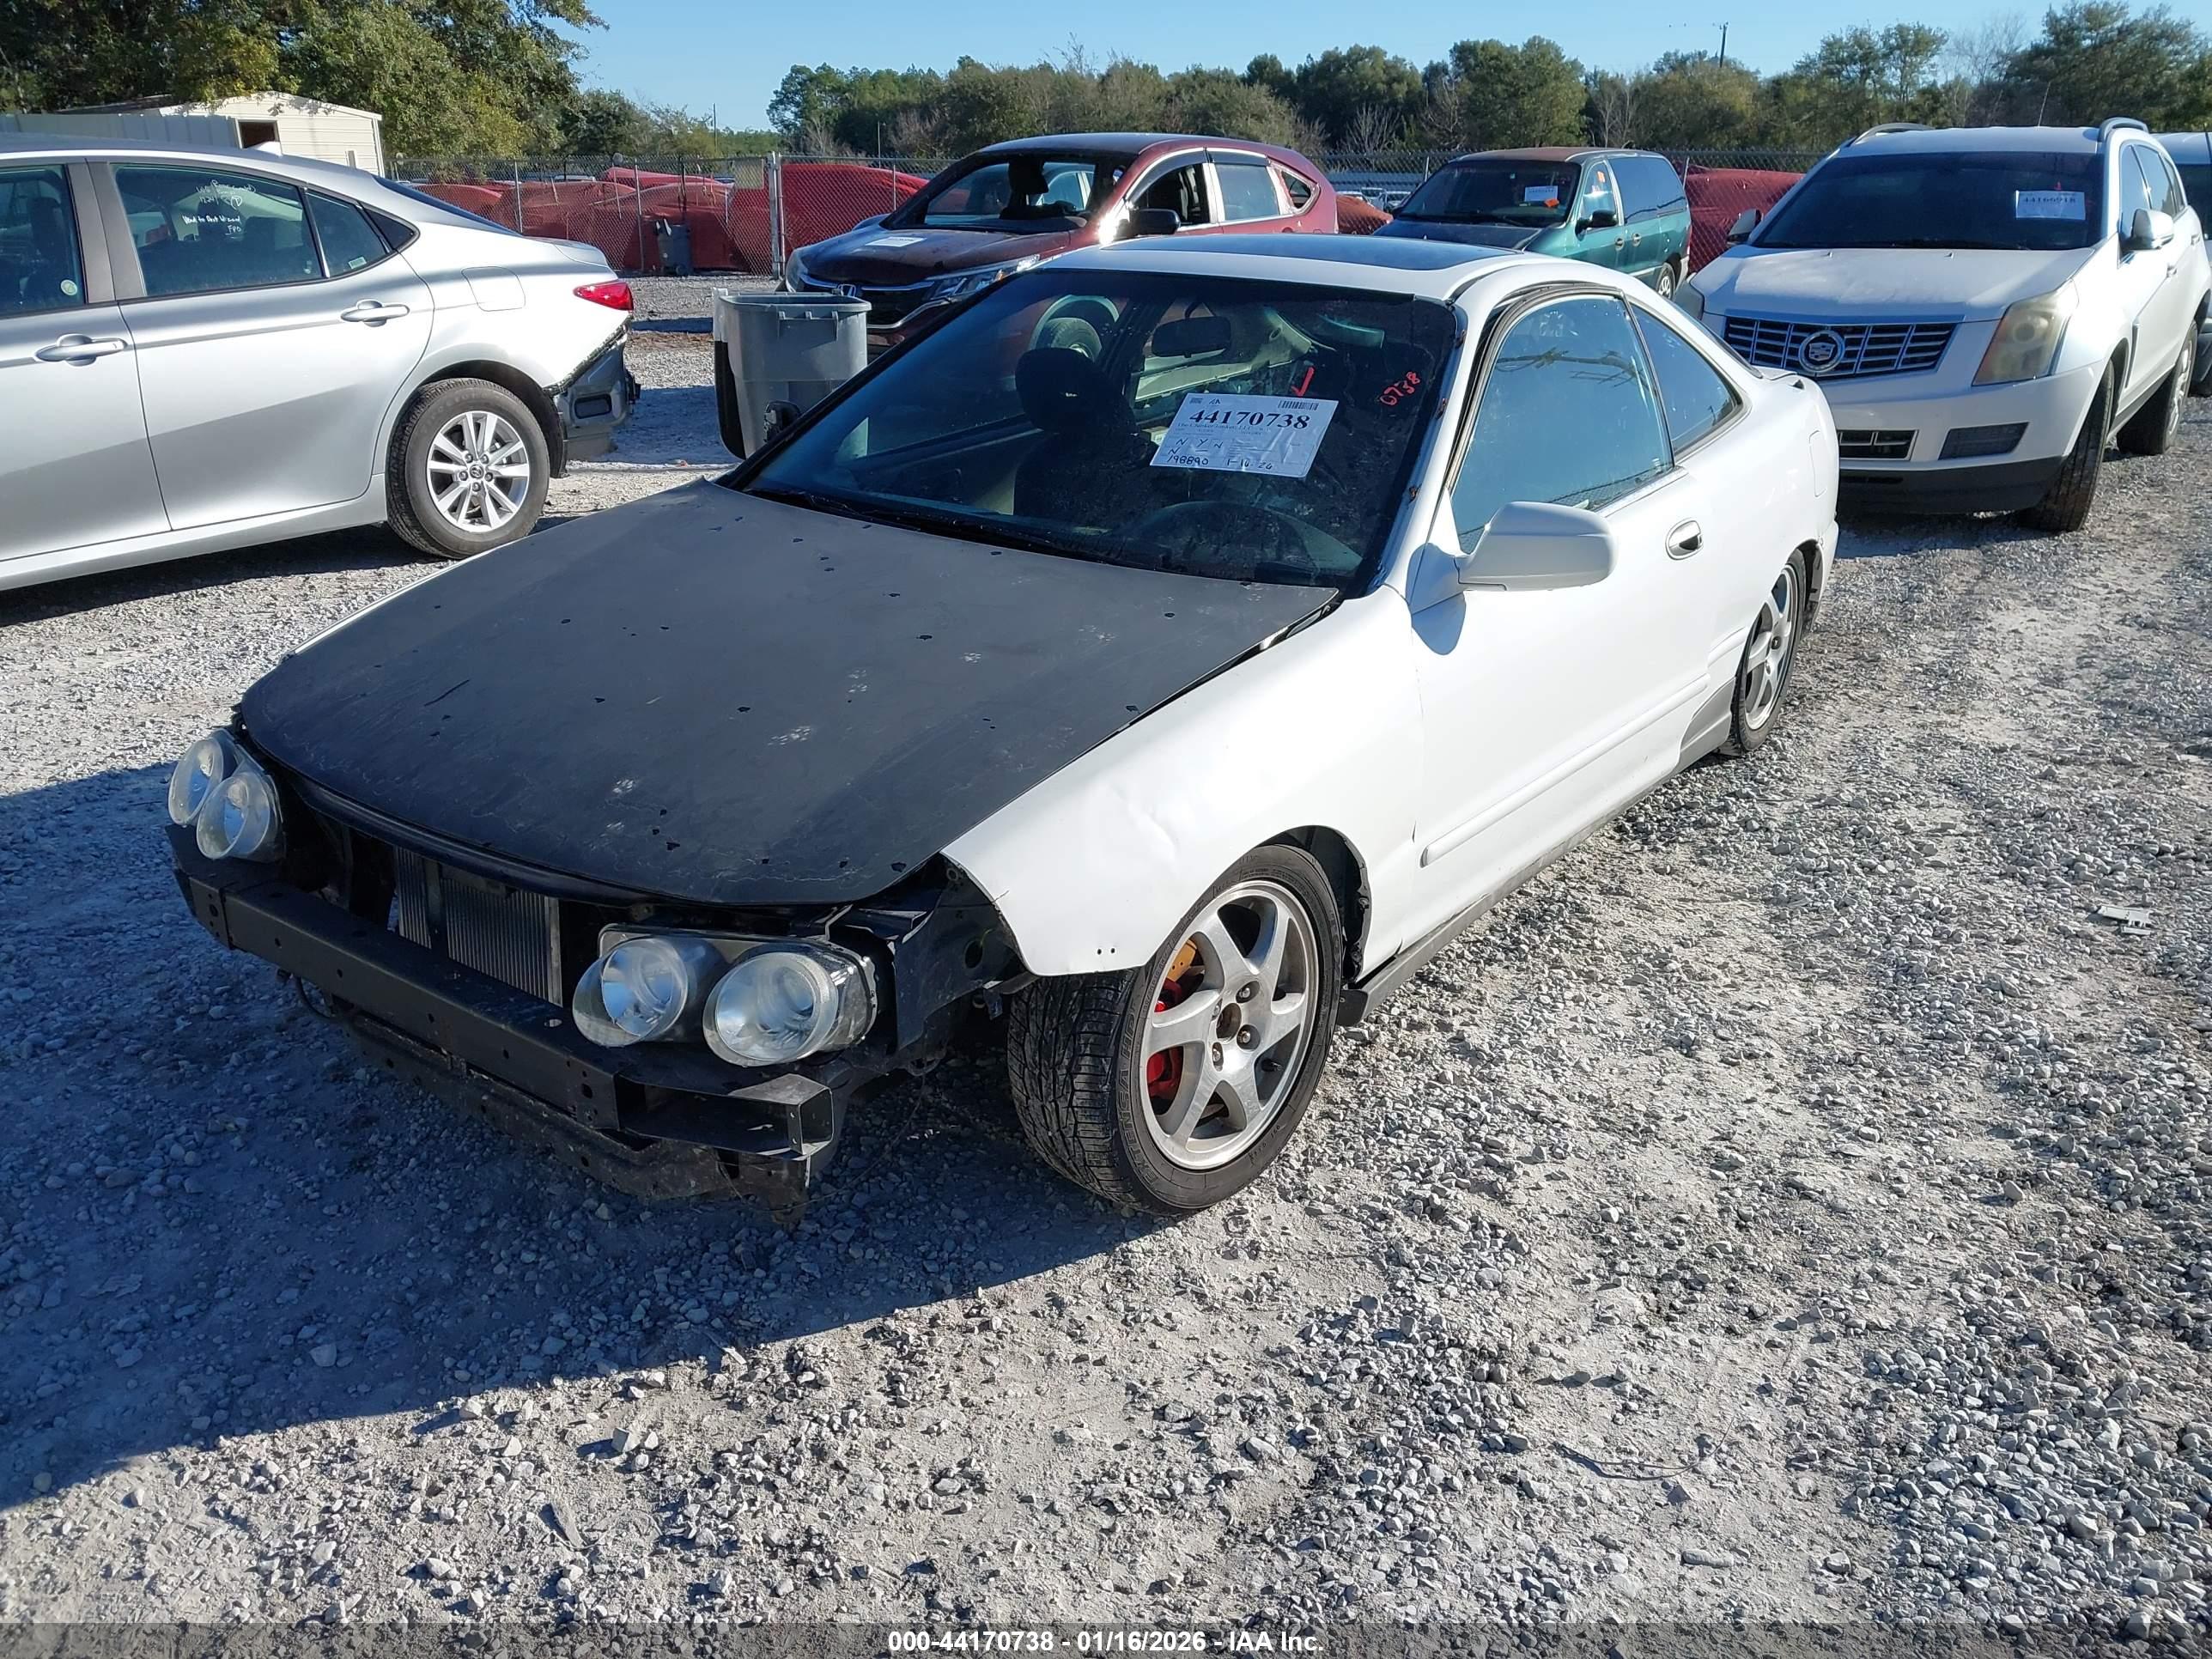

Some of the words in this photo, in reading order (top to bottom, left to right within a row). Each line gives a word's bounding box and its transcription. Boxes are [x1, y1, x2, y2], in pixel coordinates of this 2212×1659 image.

[1379, 371, 1421, 406] 0738
[1189, 410, 1310, 429] 44170738
[1120, 1067, 1159, 1187] EXTENSA
